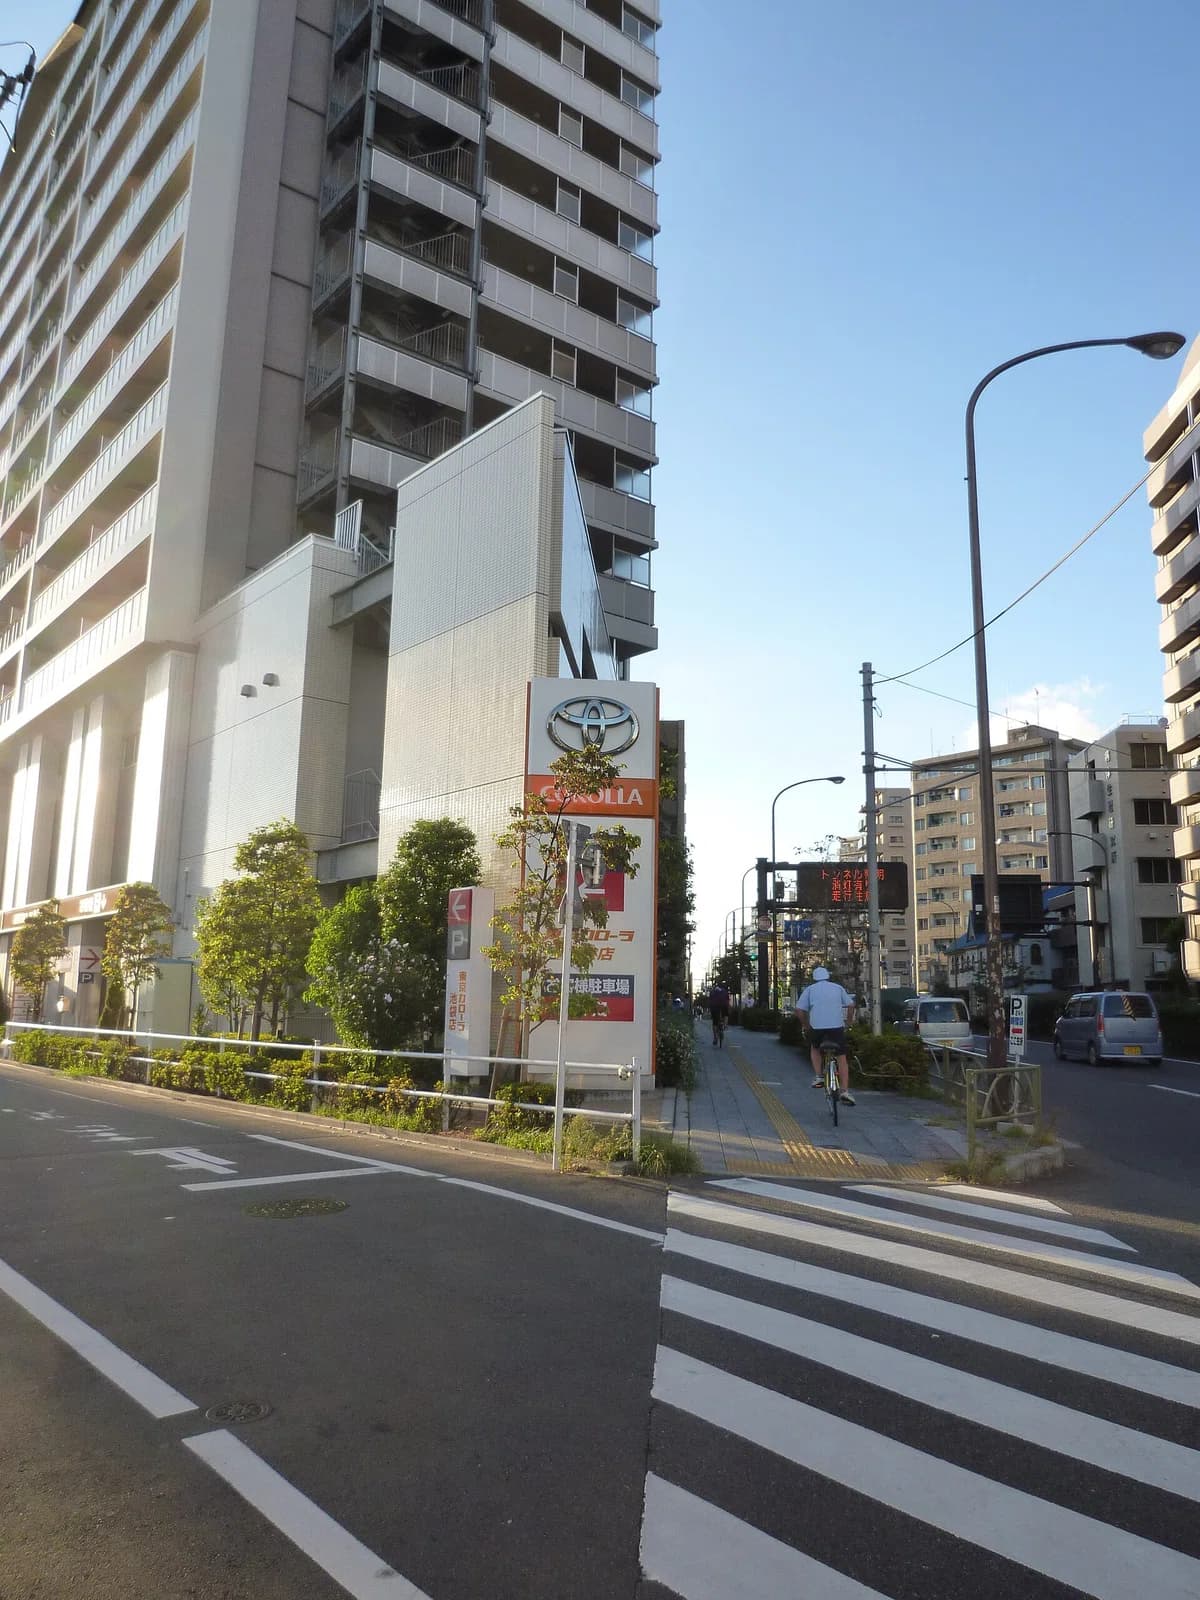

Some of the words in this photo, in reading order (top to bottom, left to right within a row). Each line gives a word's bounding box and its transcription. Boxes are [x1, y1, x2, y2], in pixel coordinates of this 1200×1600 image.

[452, 929, 464, 954] P
[81, 973, 93, 983] P
[543, 977, 630, 995] お様駐車場
[1011, 998, 1022, 1015] P
